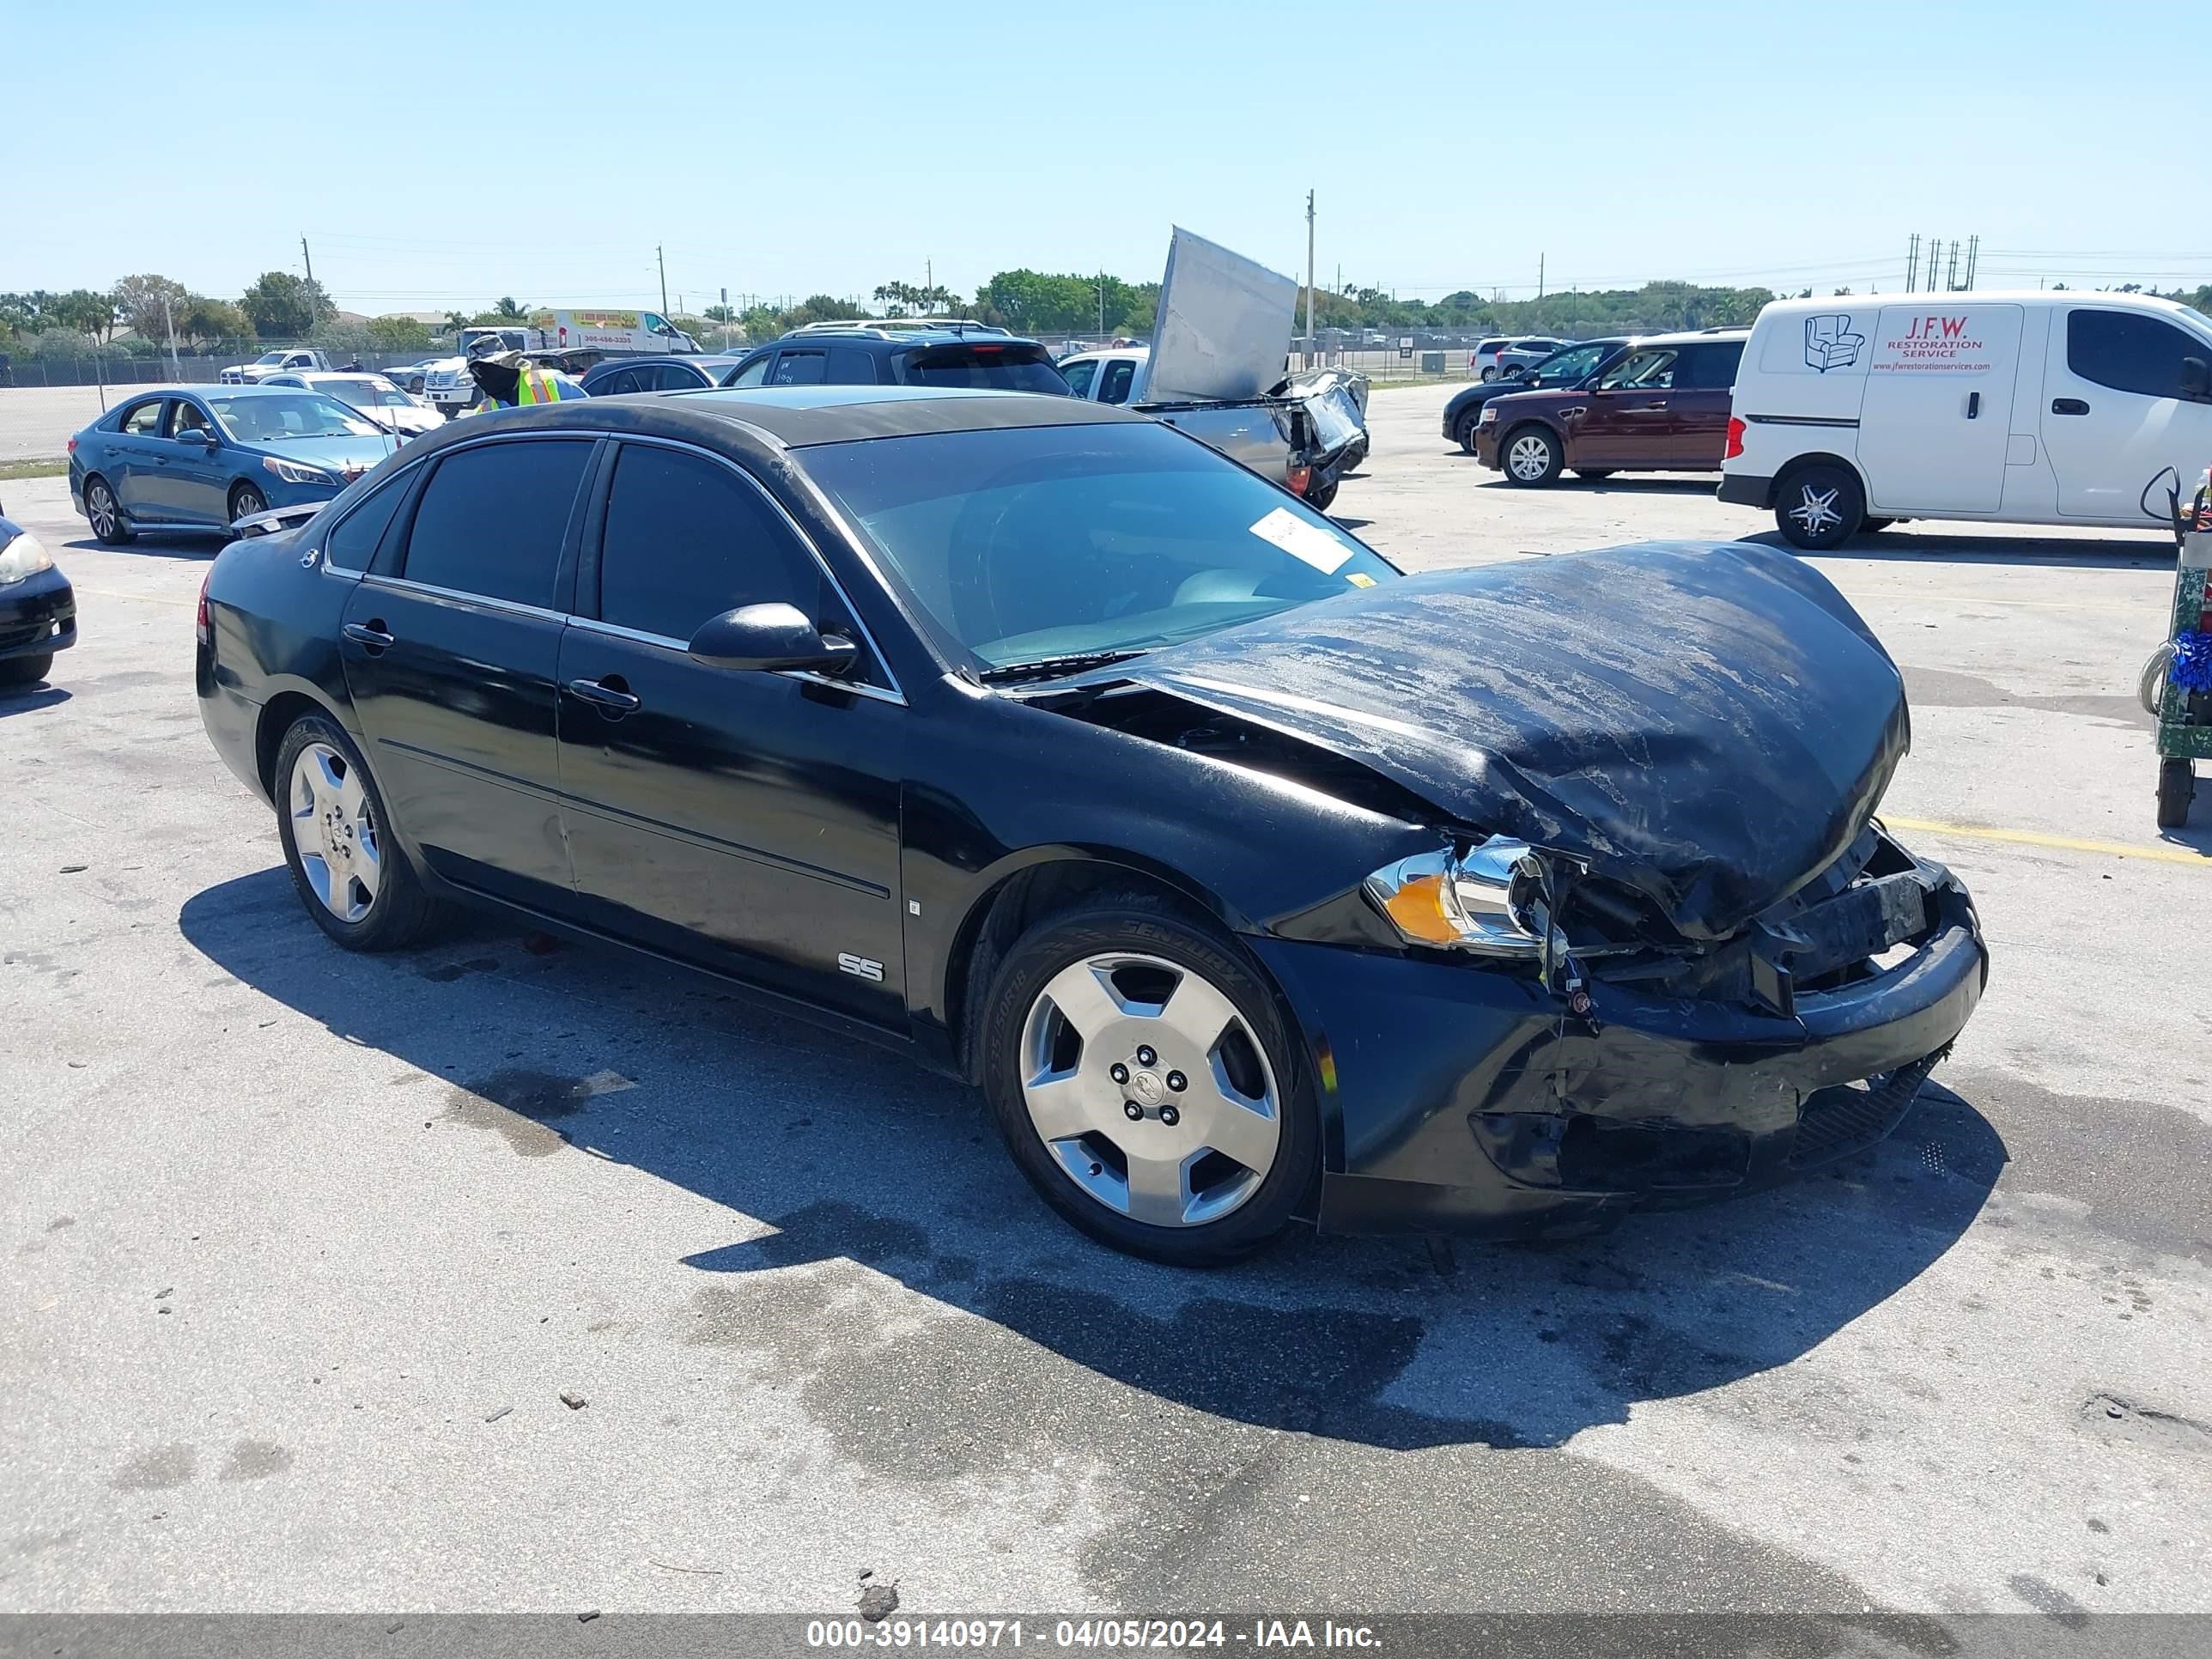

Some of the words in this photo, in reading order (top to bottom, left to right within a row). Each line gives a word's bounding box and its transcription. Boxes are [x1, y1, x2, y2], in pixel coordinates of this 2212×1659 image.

[1905, 316, 1968, 339] J.F.W.
[1887, 341, 1982, 349] RESTORATION
[1873, 362, 1990, 371] www.jfwrestorationservices.com
[838, 952, 884, 981] SS
